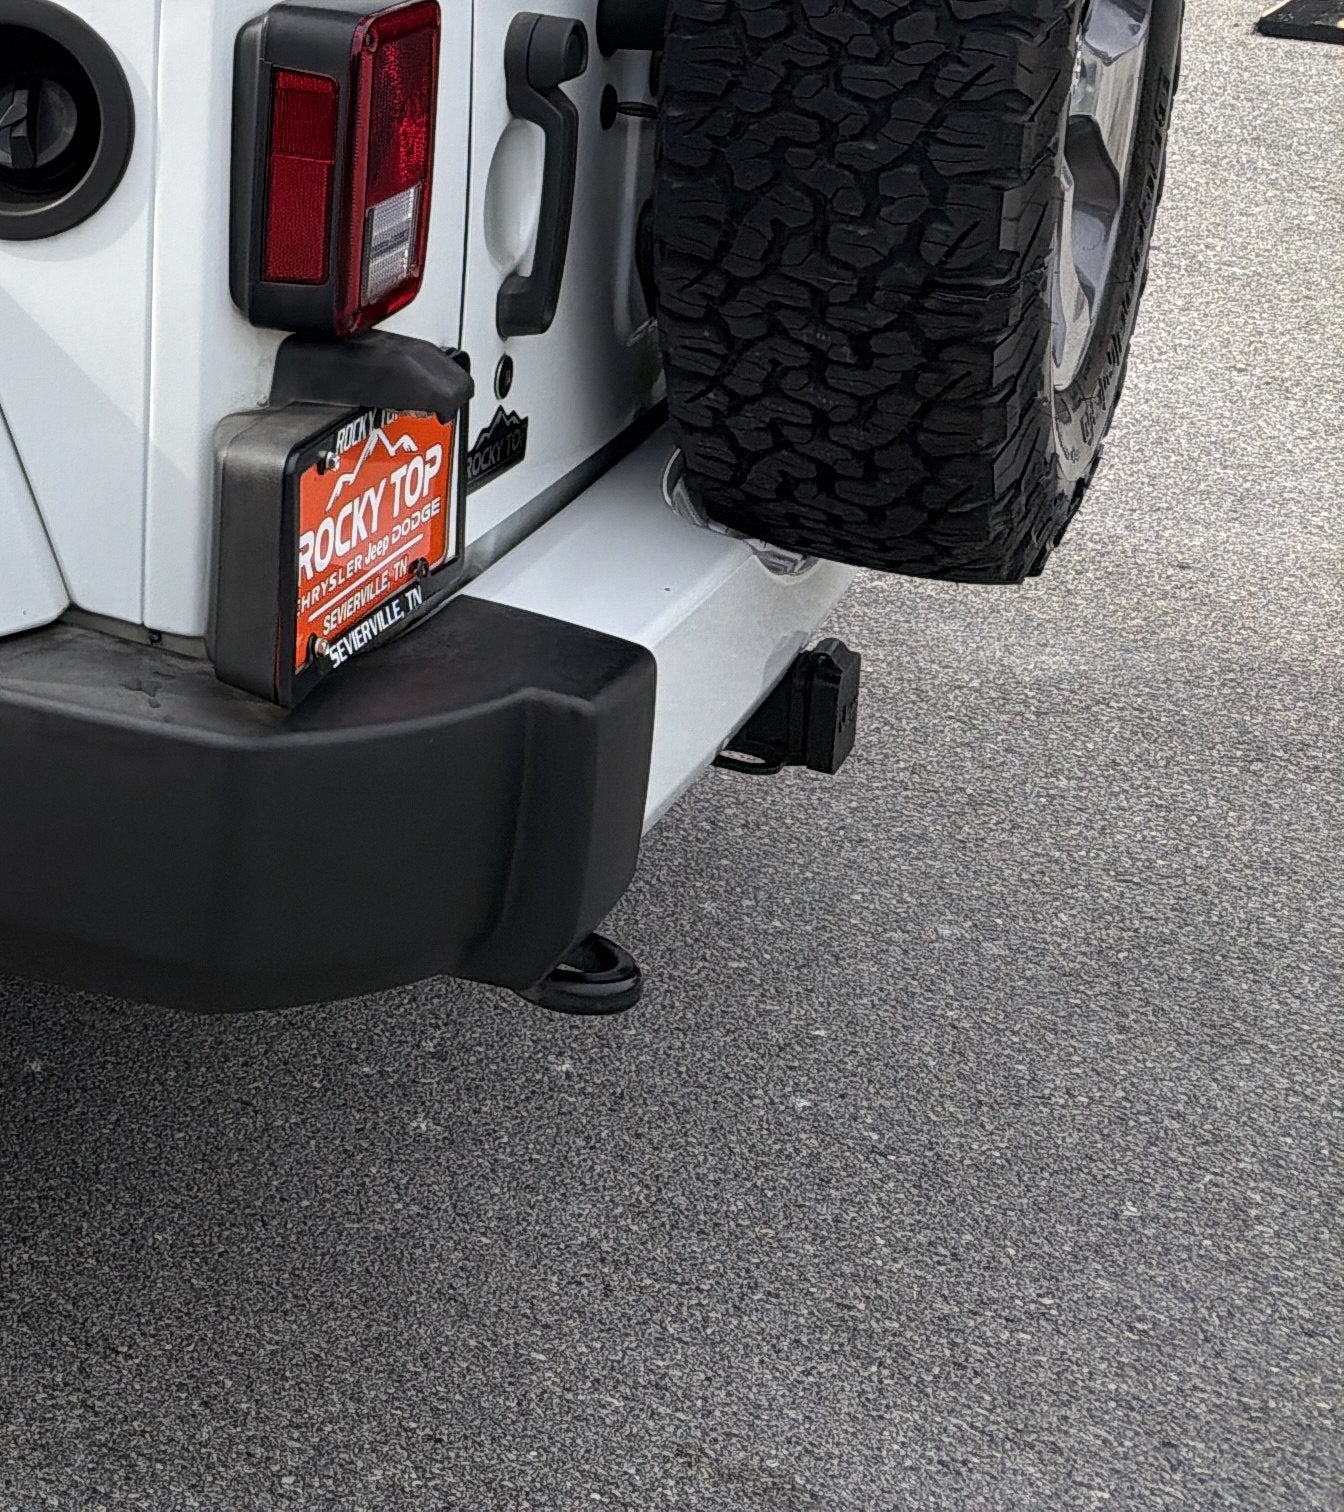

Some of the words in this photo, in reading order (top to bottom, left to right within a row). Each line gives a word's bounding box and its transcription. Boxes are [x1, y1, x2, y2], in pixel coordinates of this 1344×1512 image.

[298, 477, 387, 581] ROCKY
[390, 443, 443, 518] TOP
[364, 534, 390, 566] Jeep
[391, 496, 441, 544] DODGE
[322, 570, 392, 636] SEVIERVILLE,
[393, 556, 409, 582] TN
[329, 598, 406, 670] SEVIERVILLE,
[405, 585, 424, 611] TN
